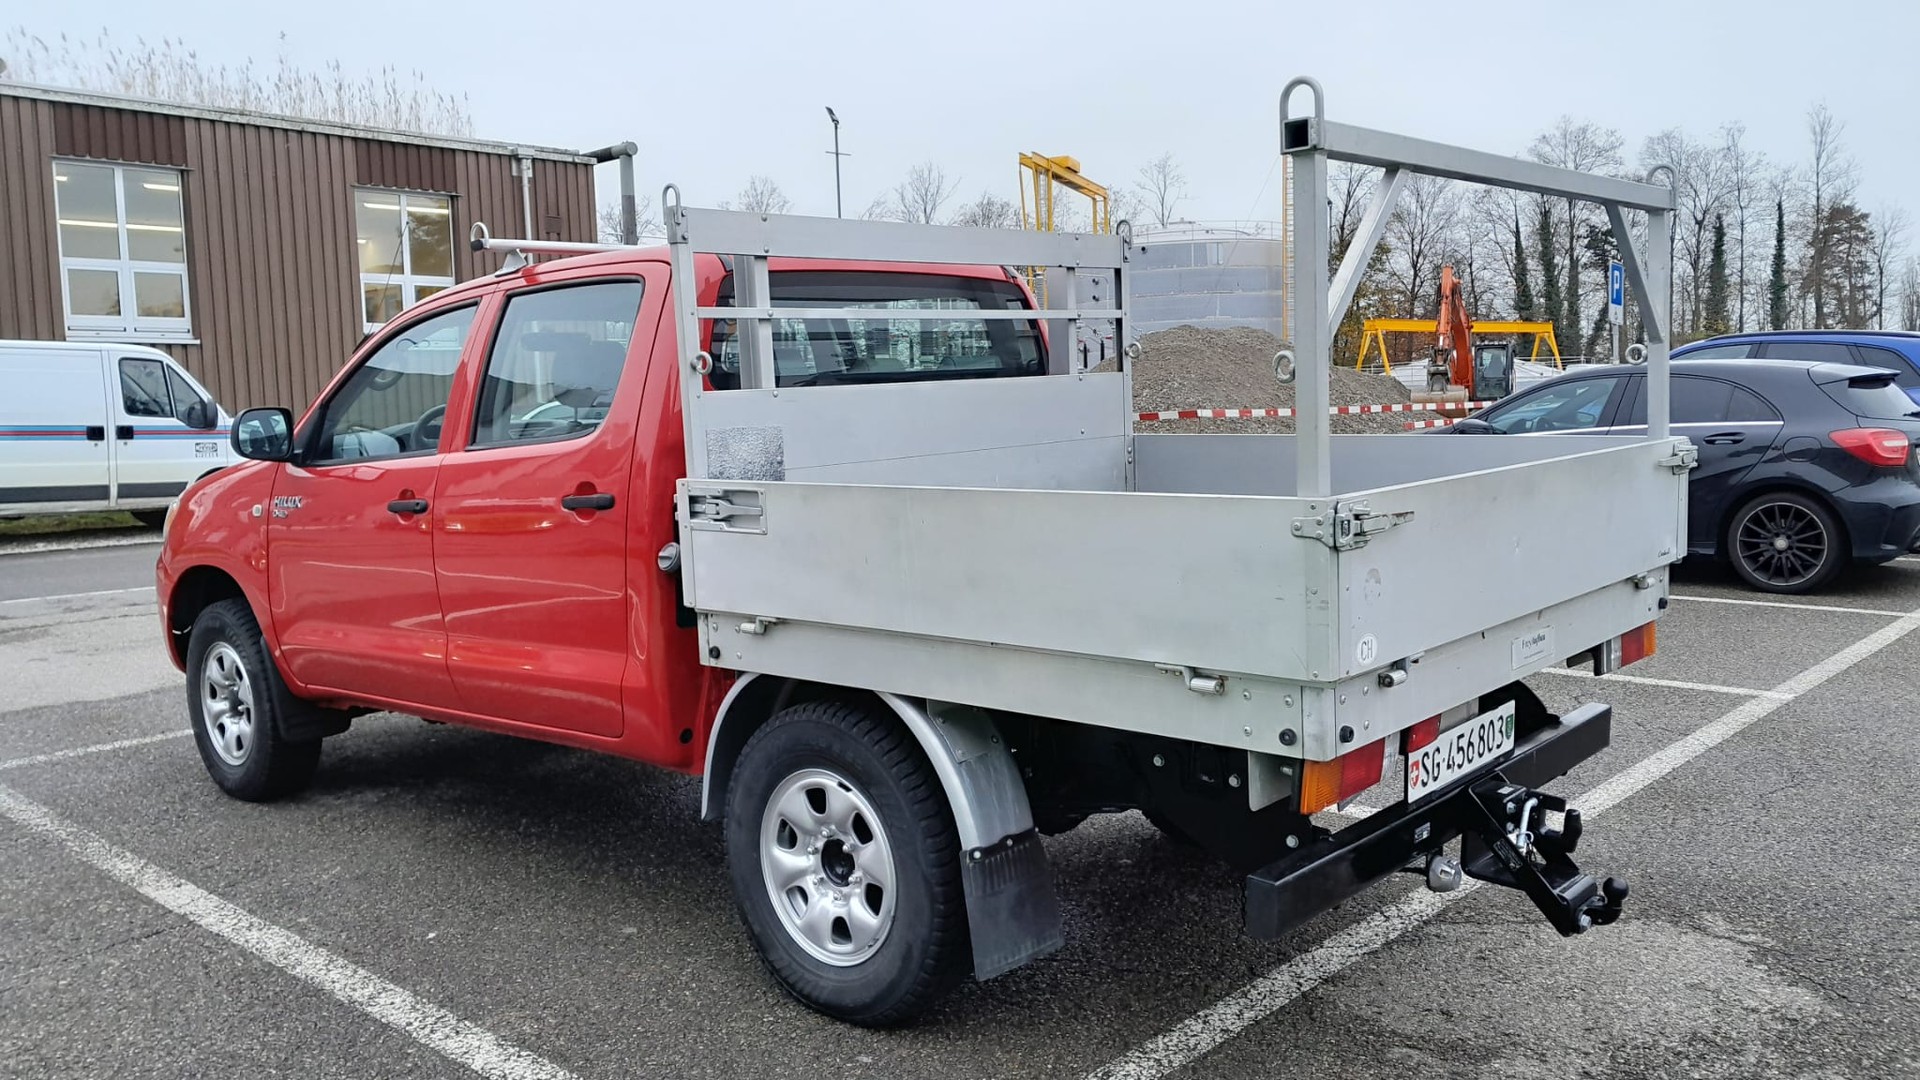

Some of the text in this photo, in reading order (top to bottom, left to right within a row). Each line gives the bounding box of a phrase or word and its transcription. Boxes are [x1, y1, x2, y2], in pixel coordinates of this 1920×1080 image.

[1613, 269, 1620, 300] P
[274, 495, 302, 508] HILUX
[1360, 639, 1373, 661] CH
